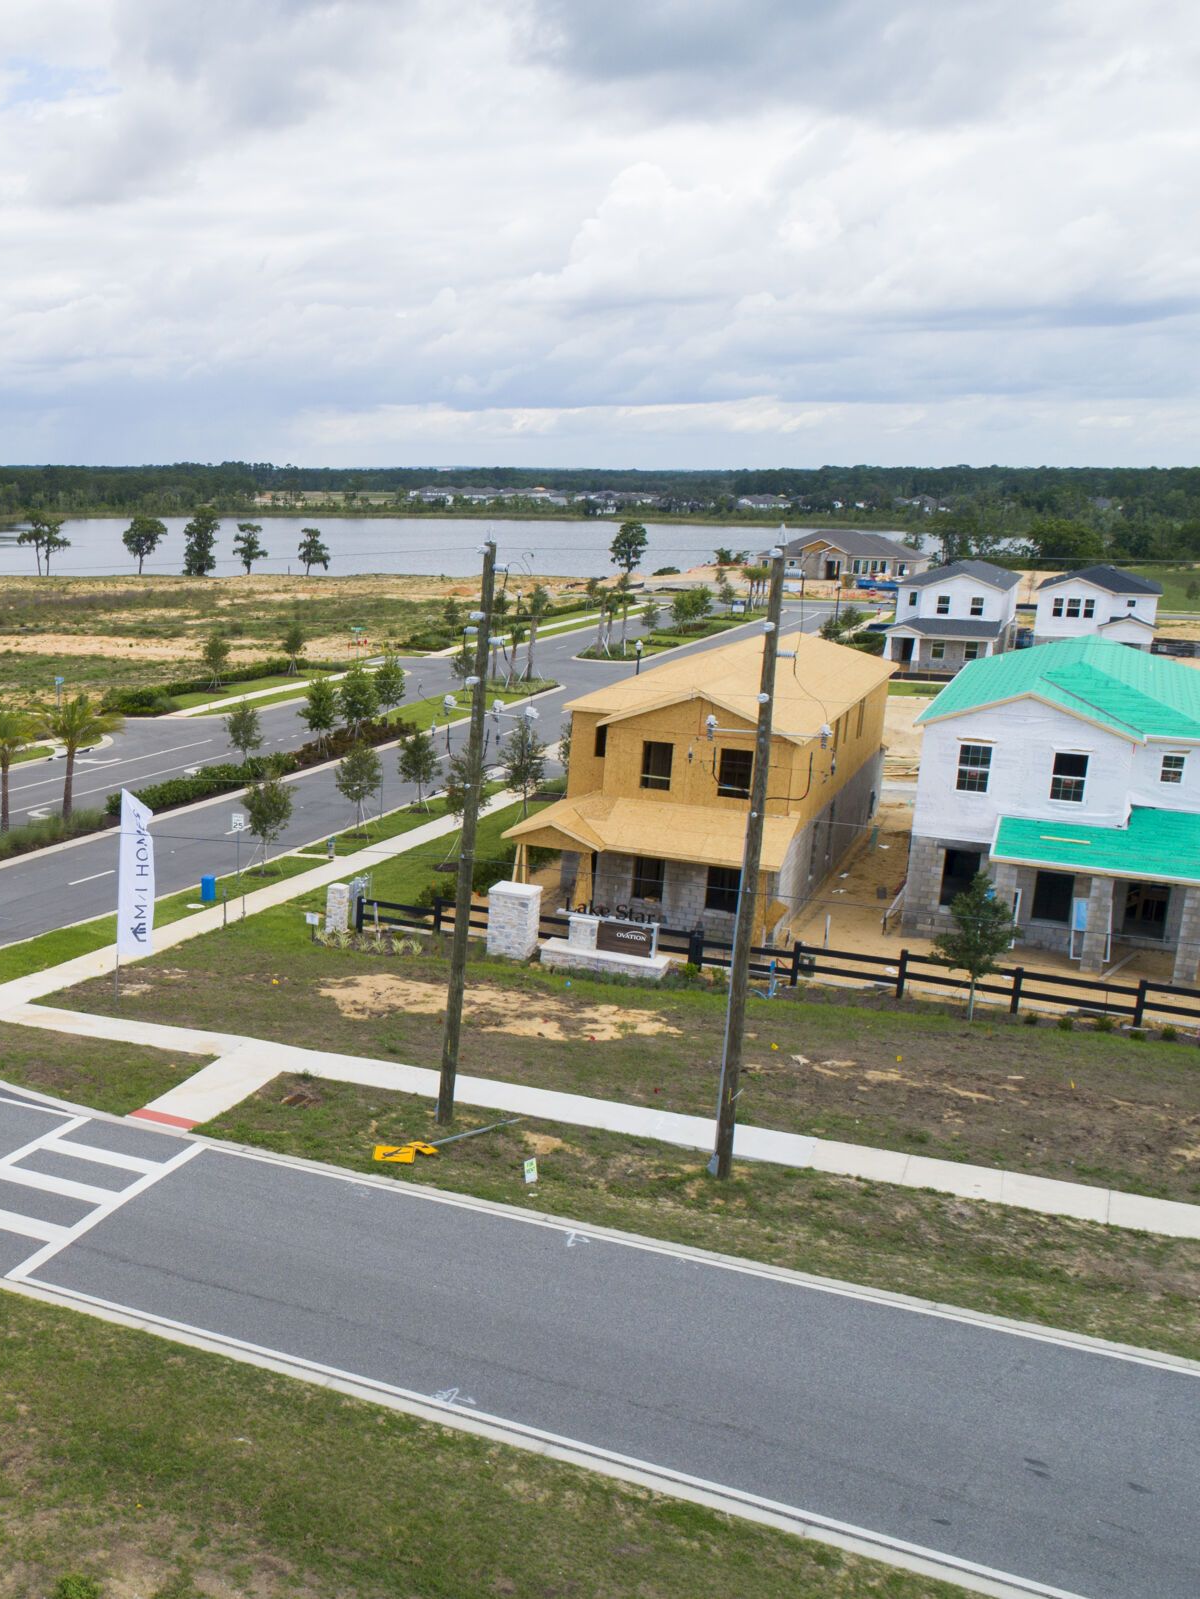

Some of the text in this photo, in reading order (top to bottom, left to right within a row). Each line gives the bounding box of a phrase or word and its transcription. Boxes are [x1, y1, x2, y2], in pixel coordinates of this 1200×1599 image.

[134, 888, 148, 919] M/I
[565, 896, 656, 925] Lake Star
[616, 931, 647, 942] OVATION
